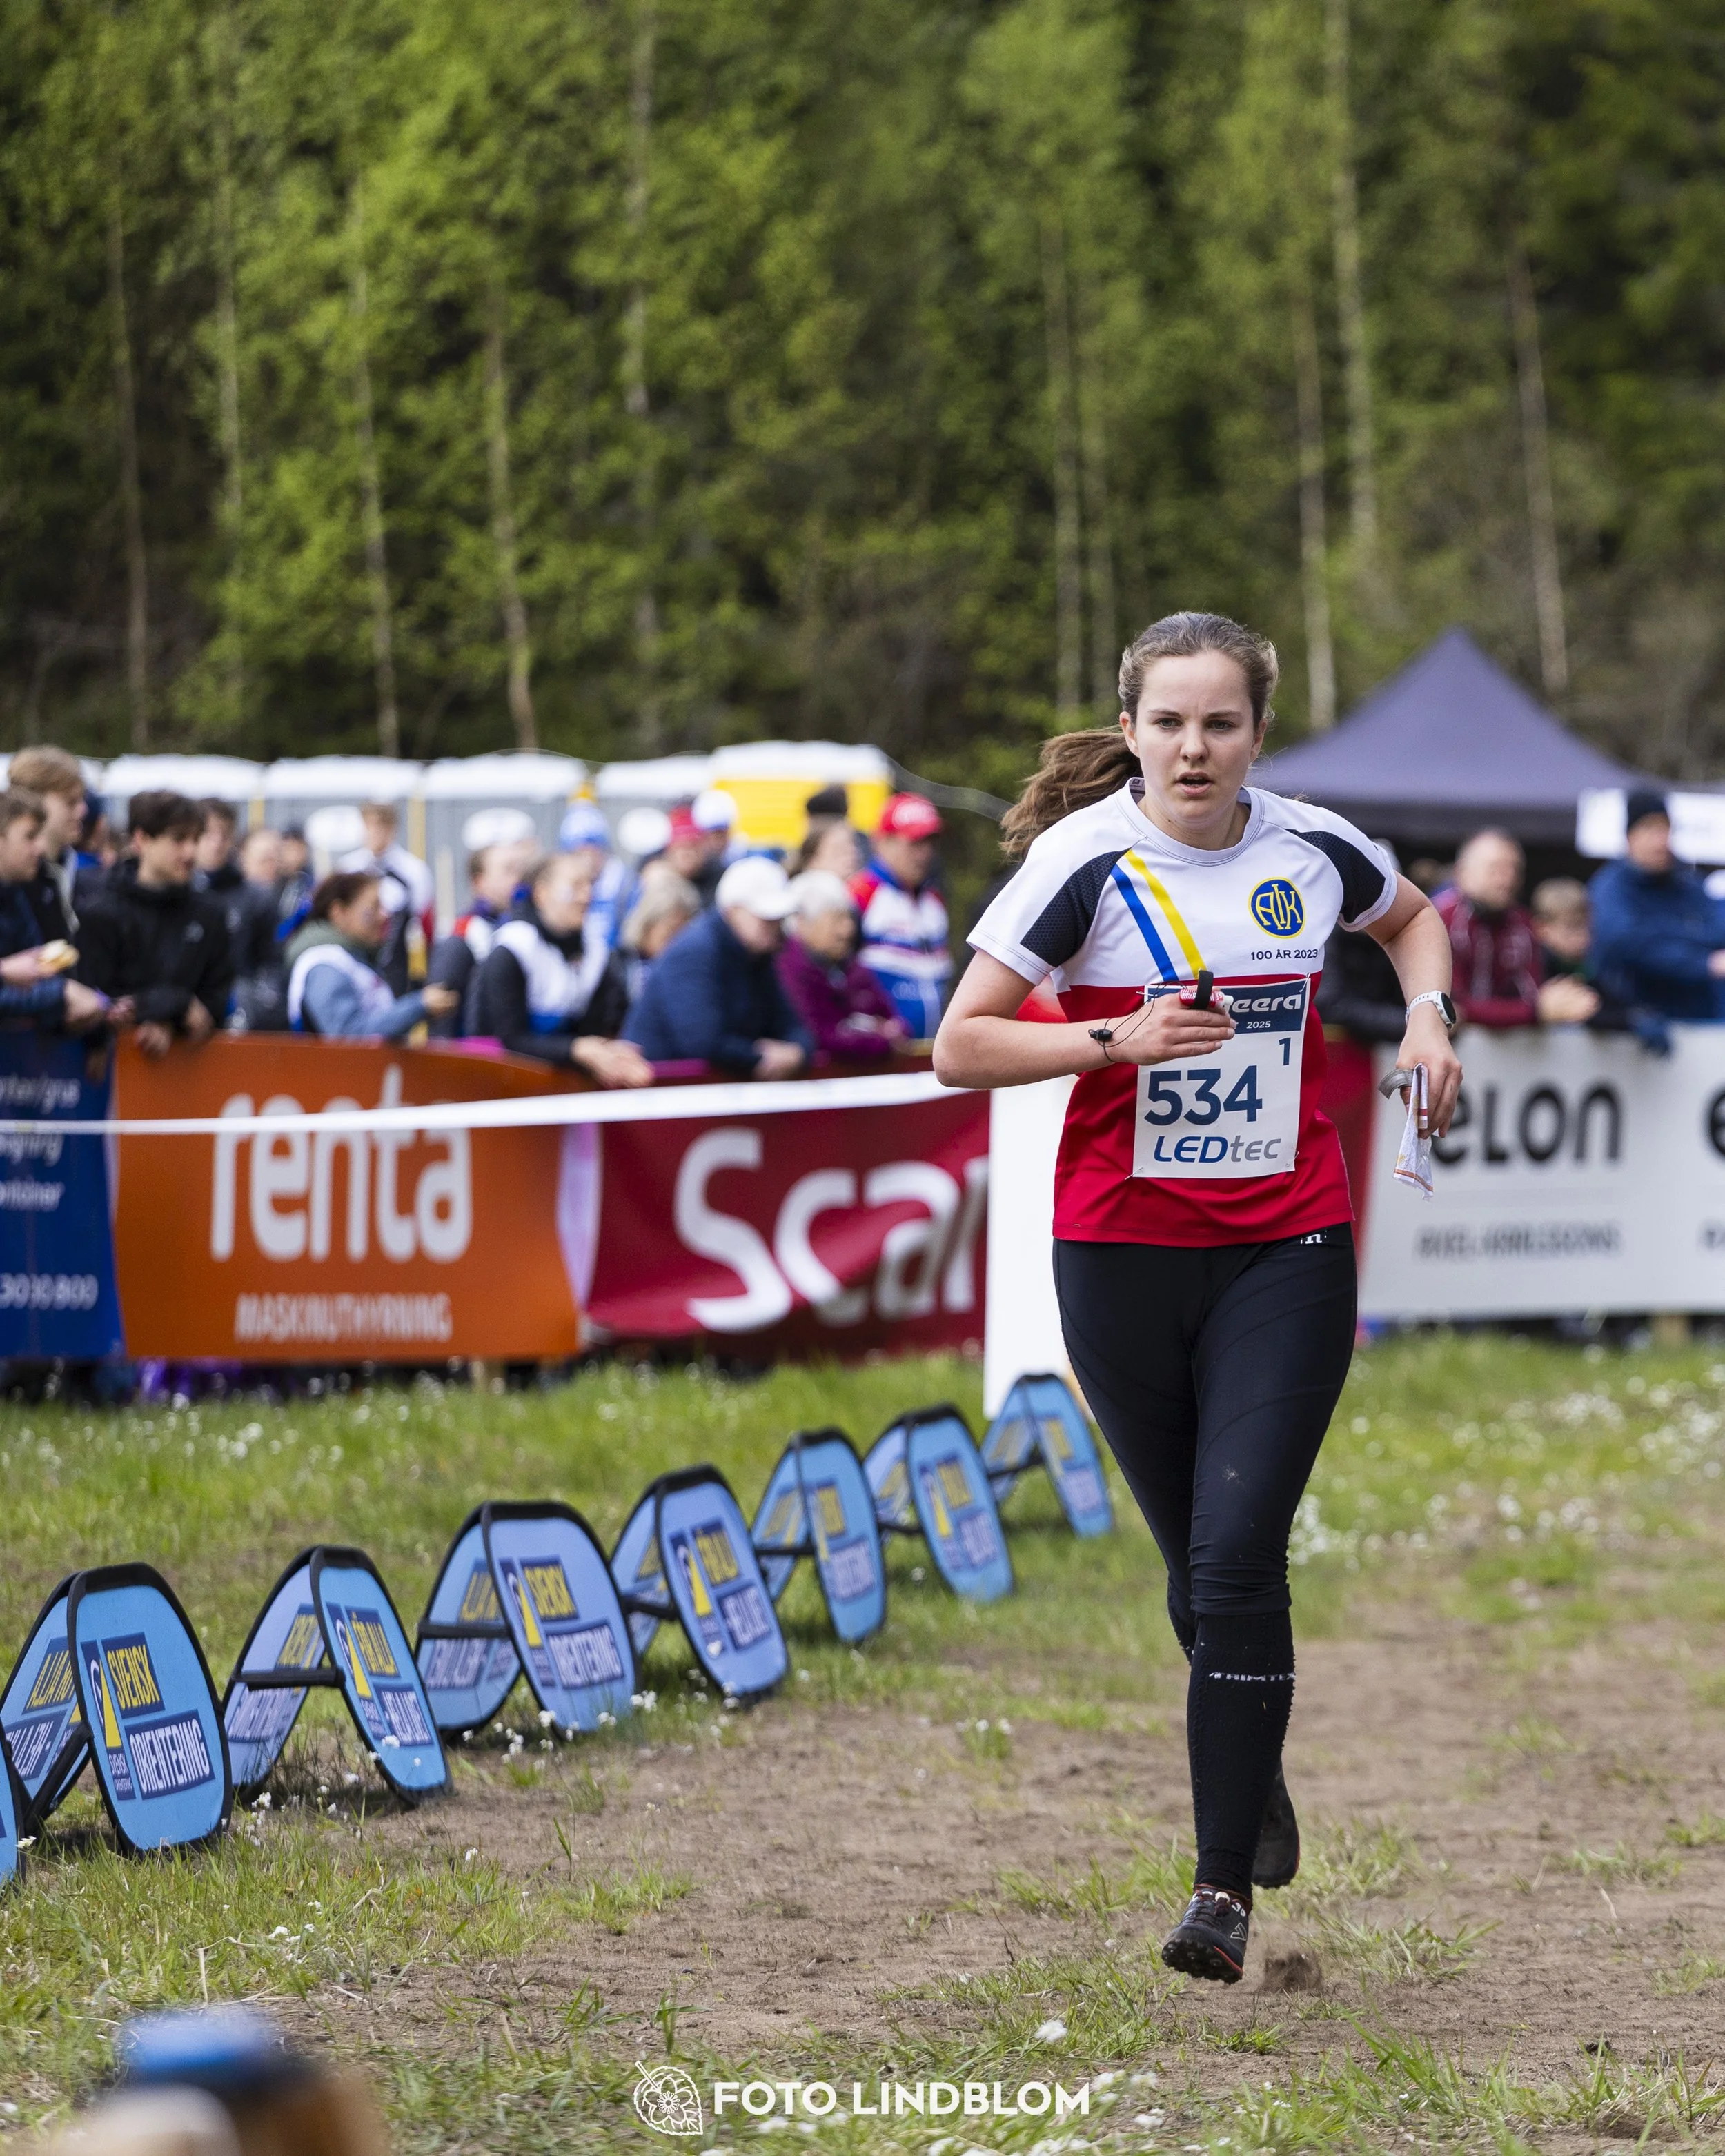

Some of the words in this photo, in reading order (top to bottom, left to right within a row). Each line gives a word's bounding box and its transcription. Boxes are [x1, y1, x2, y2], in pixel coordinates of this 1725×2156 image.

[1256, 884, 1302, 930] AIK
[1251, 951, 1272, 960] 100
[1275, 949, 1292, 959] ÅR
[1294, 949, 1319, 959] 2023
[1232, 994, 1302, 1013] eera
[1279, 1037, 1291, 1066] 1
[1144, 1065, 1263, 1126] 534
[210, 1063, 472, 1263] renta
[1154, 1136, 1281, 1163] LEDtec
[107, 1645, 160, 1710] SVENSK
[129, 1719, 210, 1794] ORIENTERING
